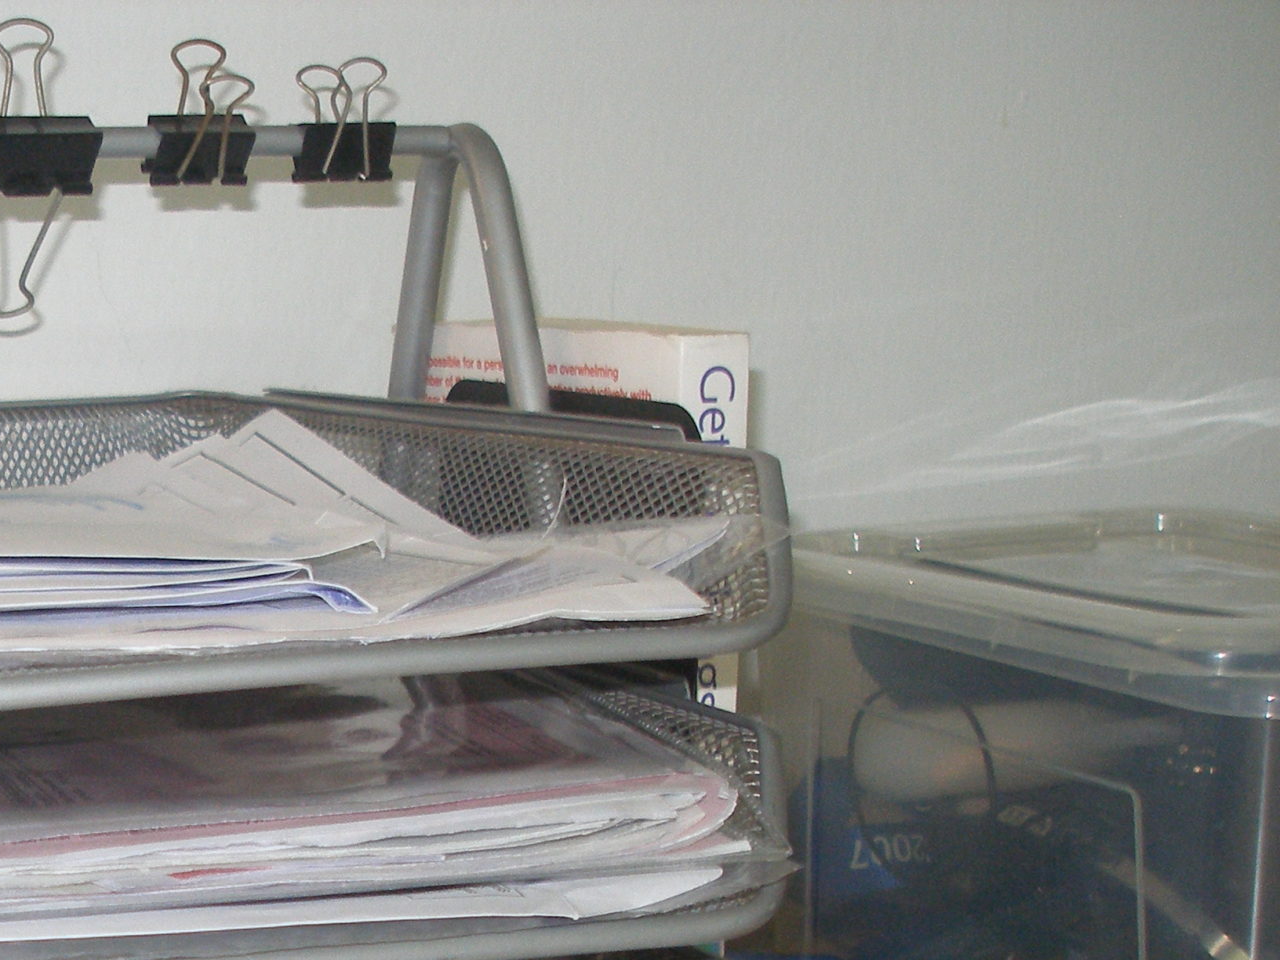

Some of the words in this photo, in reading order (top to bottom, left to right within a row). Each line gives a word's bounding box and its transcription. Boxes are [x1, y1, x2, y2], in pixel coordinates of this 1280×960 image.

[463, 356, 474, 369] for
[547, 364, 558, 375] an
[559, 363, 619, 382] overwhelming
